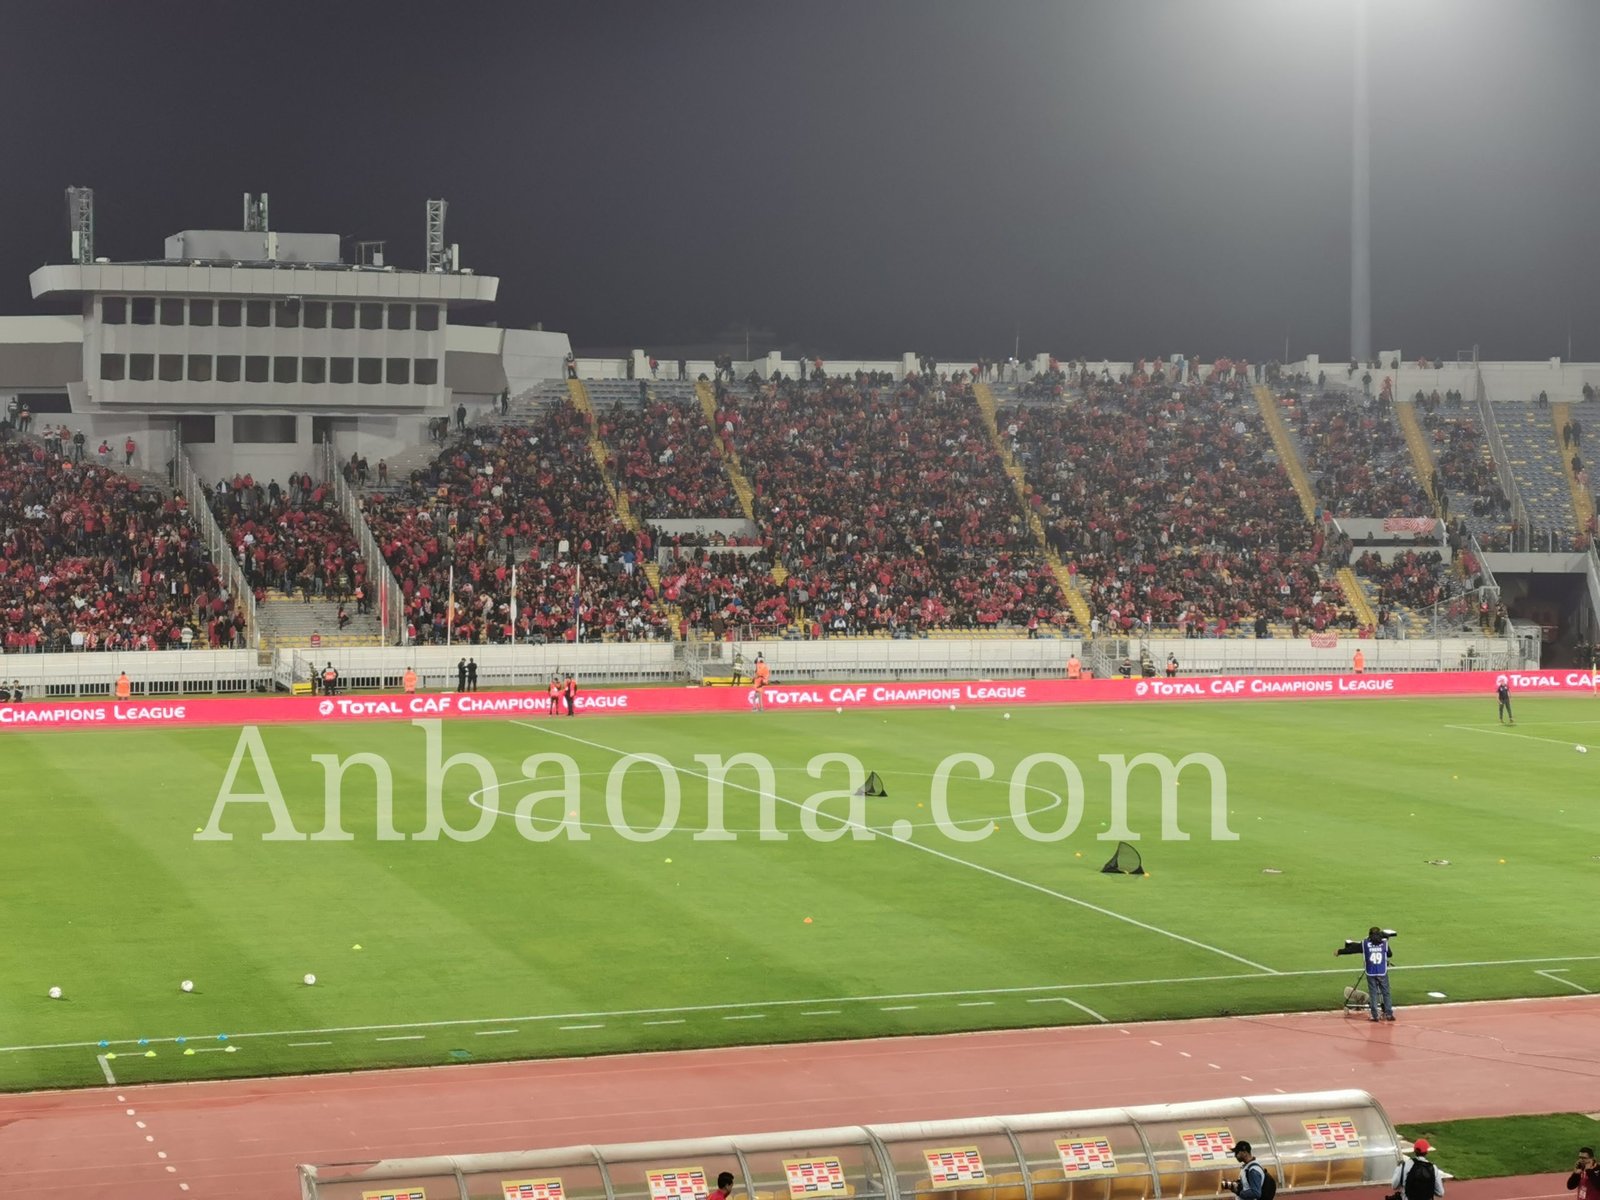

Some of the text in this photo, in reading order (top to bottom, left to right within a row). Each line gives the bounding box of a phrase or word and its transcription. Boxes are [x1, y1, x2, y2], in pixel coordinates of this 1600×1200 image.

[1153, 678, 1393, 695] TOTAL CAF CHAMPIONS LEAGUE
[1510, 675, 1560, 686] TOTAL
[764, 686, 1026, 703] TOTAL CAF CHAMPIONS LEAGUE
[337, 700, 402, 714] TOTAL
[410, 697, 450, 712] CAF
[0, 706, 185, 722] CHAMPIONS LEAGUE
[1370, 952, 1382, 964] 49
